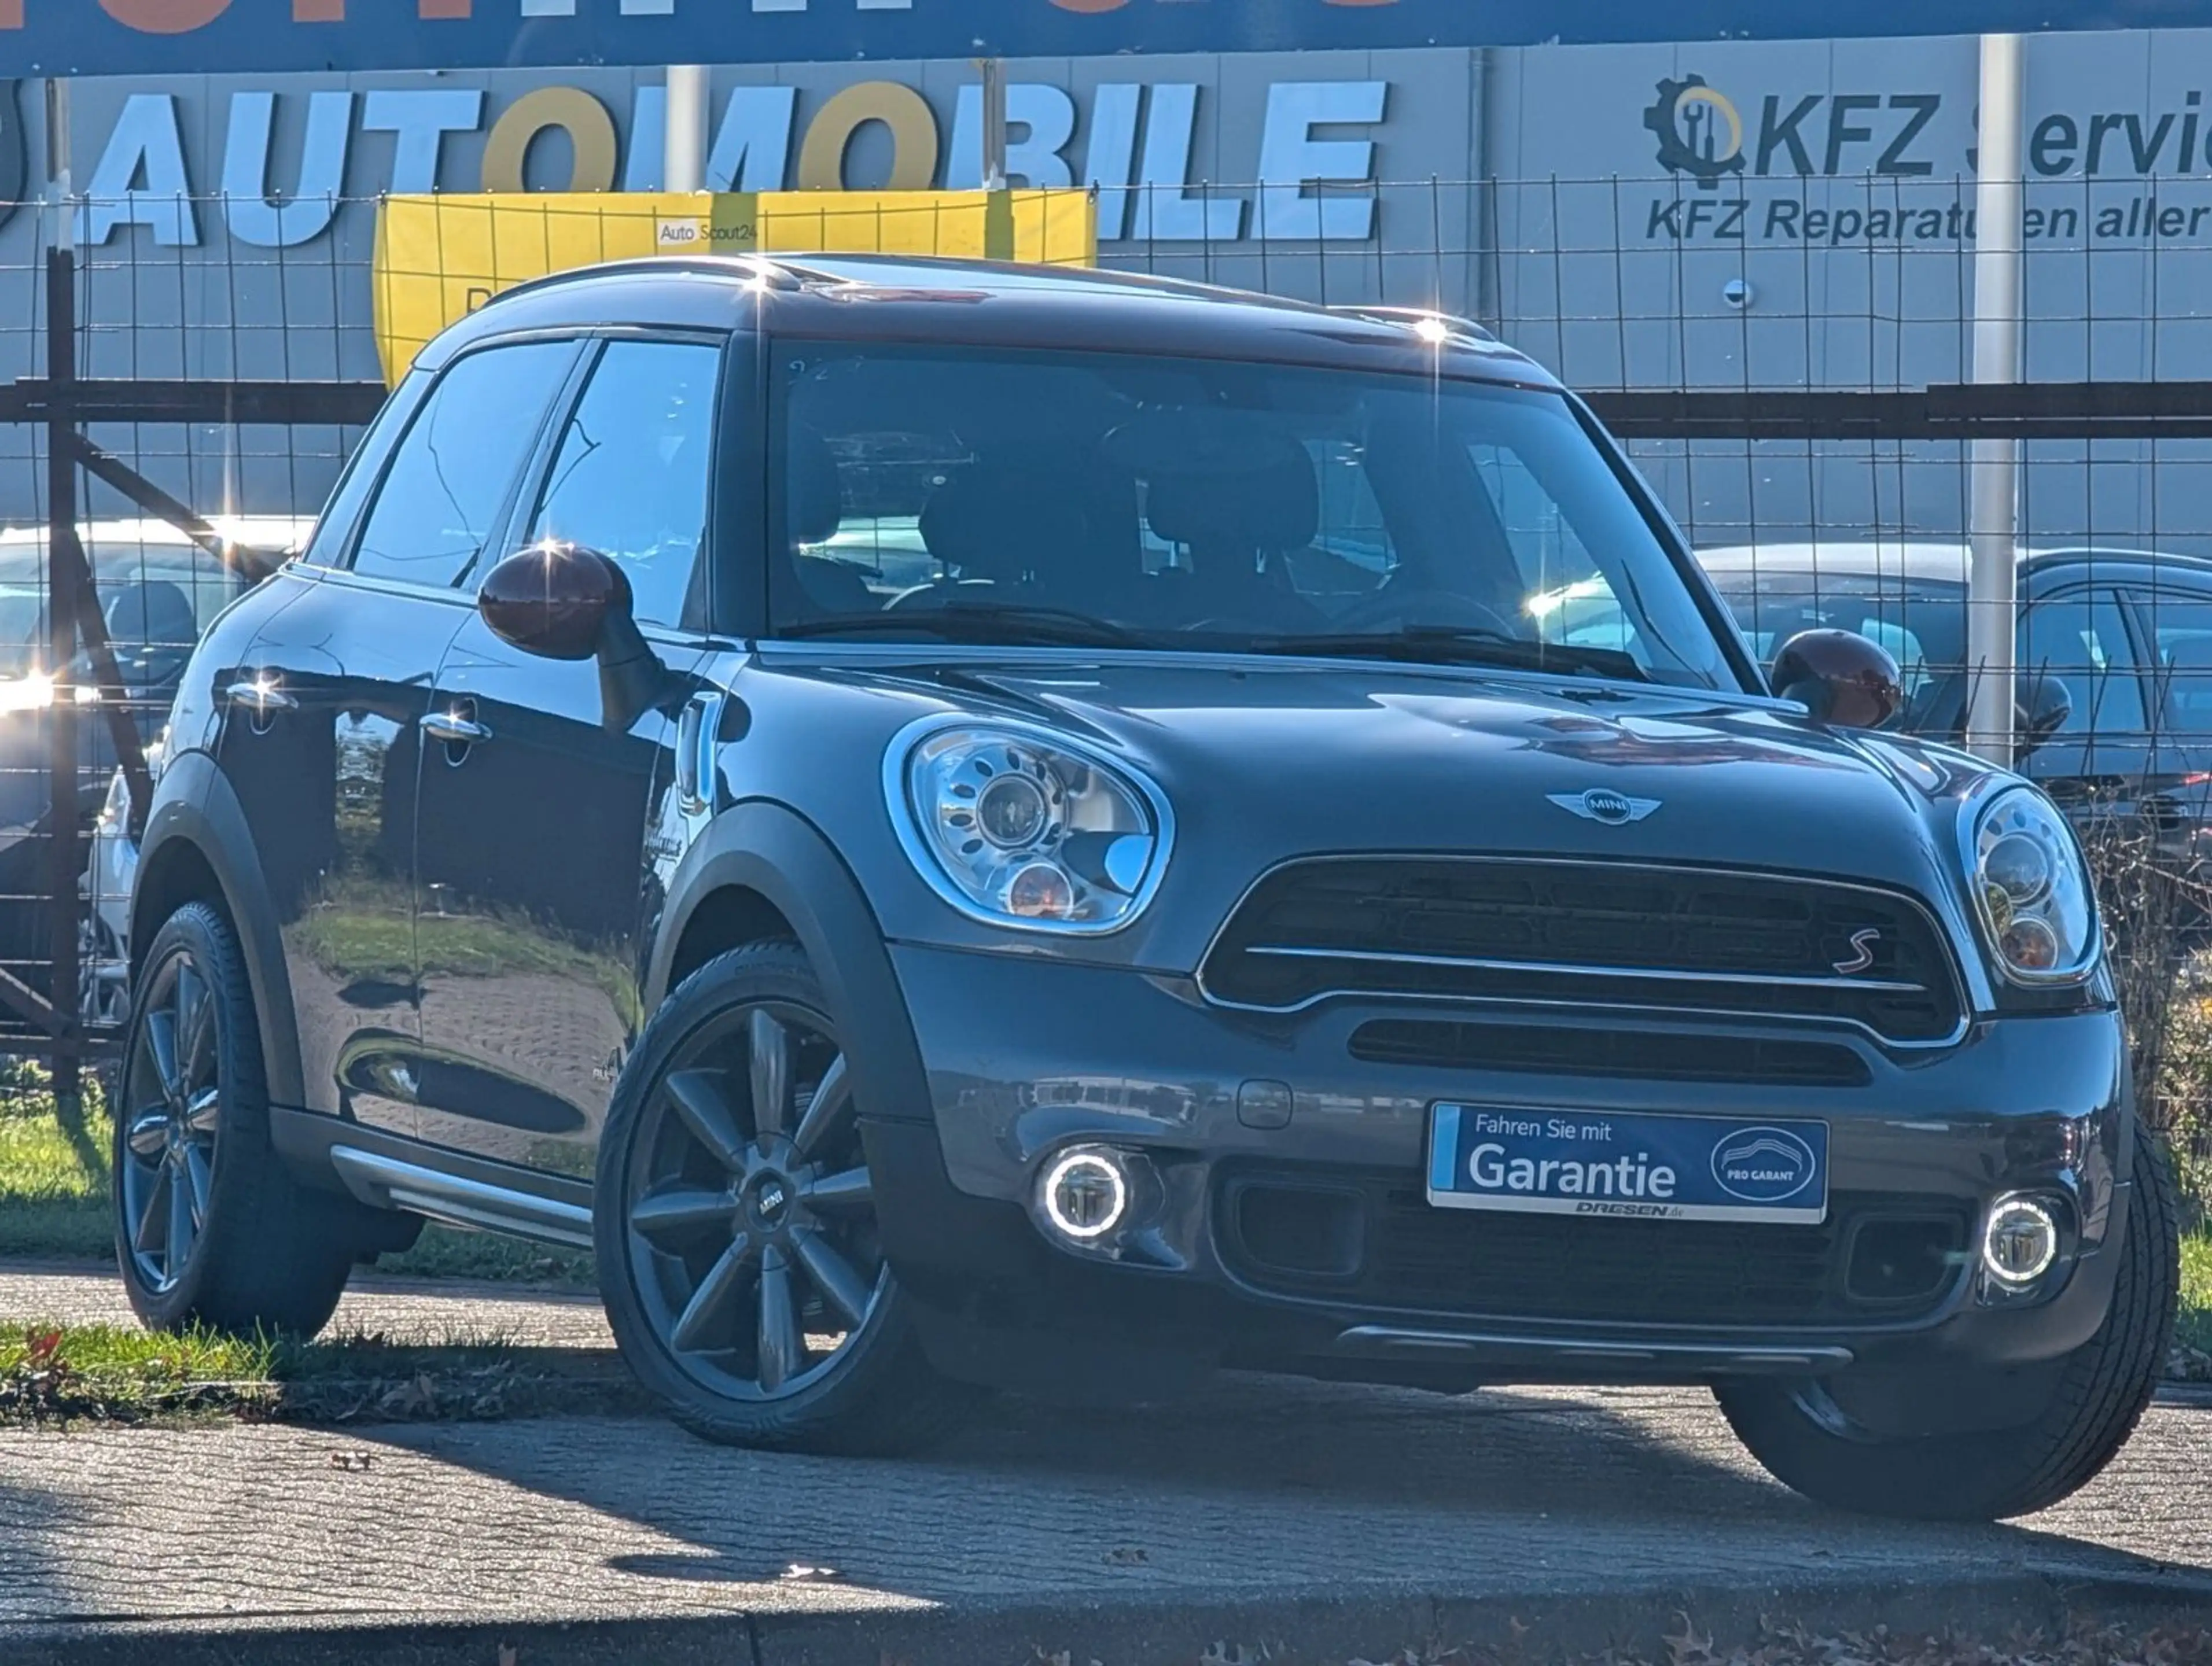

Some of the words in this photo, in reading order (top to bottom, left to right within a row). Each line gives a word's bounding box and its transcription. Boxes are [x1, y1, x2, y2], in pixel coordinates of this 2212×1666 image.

[1755, 94, 1941, 176] KFZ
[1966, 91, 2212, 175] ervi
[660, 224, 695, 241] Auto
[1646, 200, 1750, 238] KFZ
[1763, 200, 2078, 246] Reparaten
[2095, 197, 2211, 238] aller
[1589, 798, 1626, 810] MINI
[1832, 928, 1880, 974] S
[1476, 1114, 1541, 1137] Fahren
[1547, 1119, 1576, 1140] Sie
[1581, 1122, 1612, 1141] mit
[1469, 1142, 1676, 1198] Garantie
[1727, 1170, 1749, 1180] PRO
[1750, 1170, 1794, 1181] GARANT
